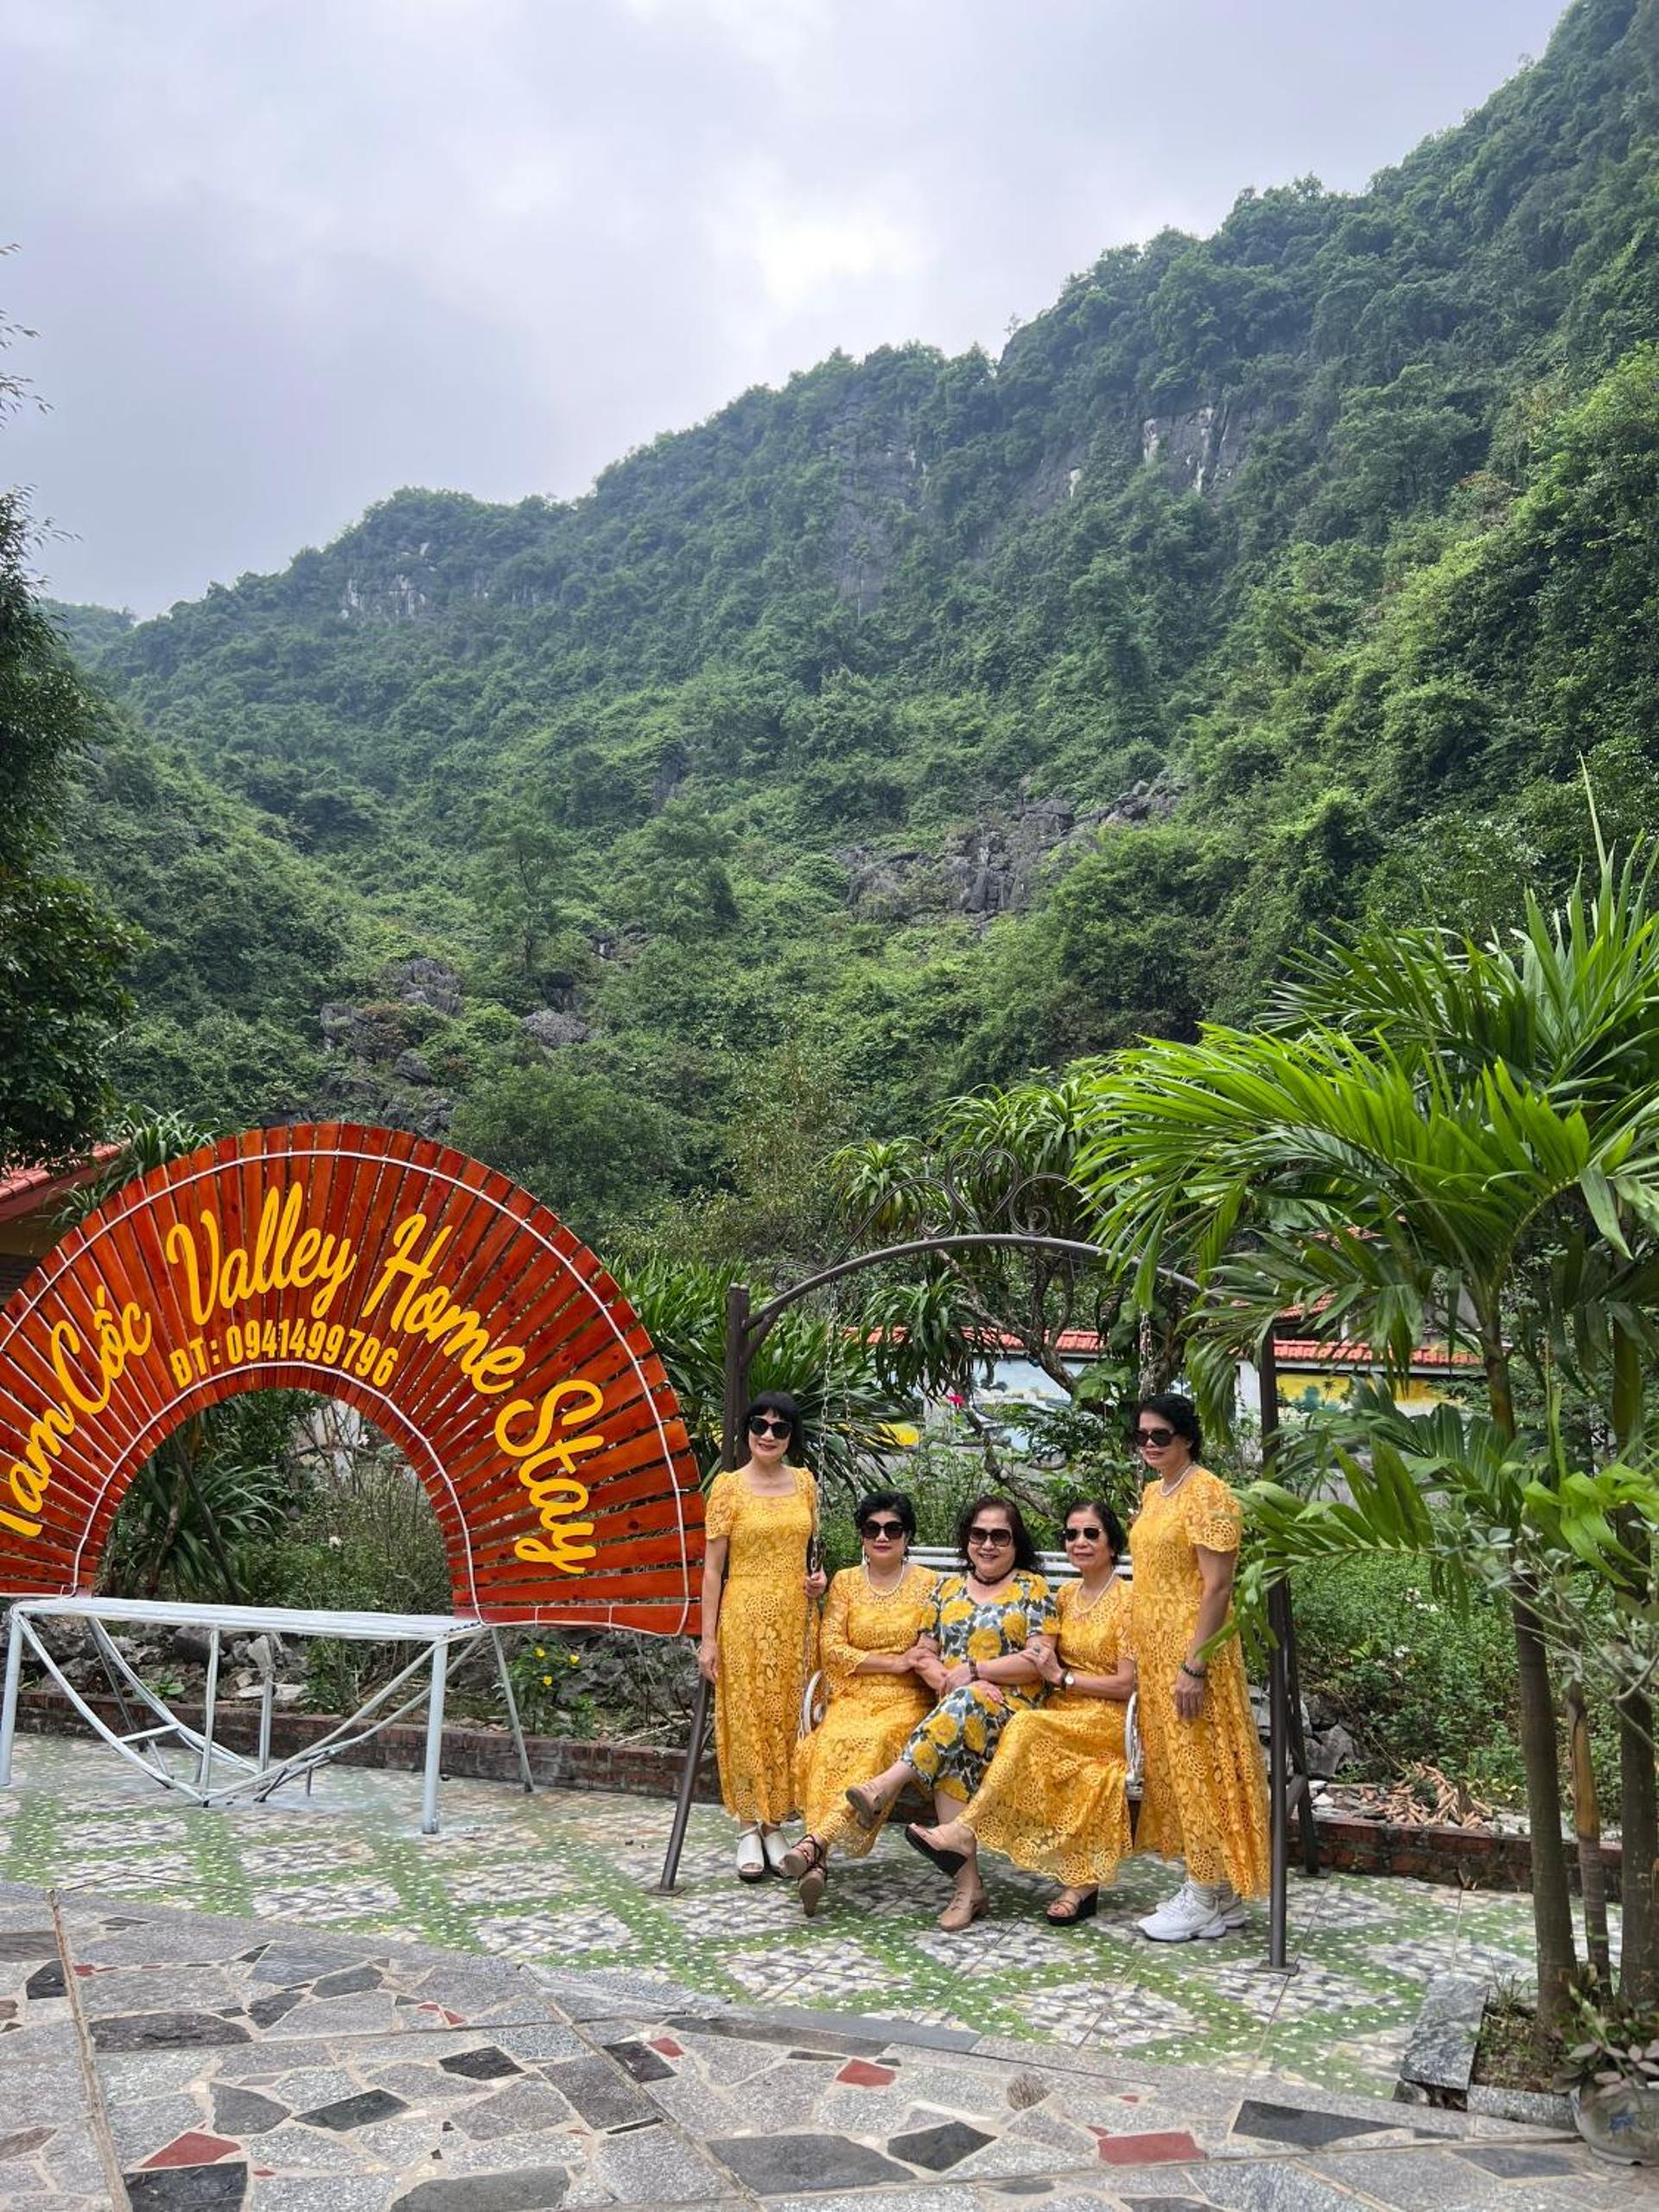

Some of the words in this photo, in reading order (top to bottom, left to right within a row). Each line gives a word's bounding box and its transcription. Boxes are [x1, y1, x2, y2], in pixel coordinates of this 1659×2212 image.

[51, 1285, 152, 1414] Cốc
[166, 1182, 356, 1326] Valley
[361, 1212, 525, 1395] Home
[494, 1380, 604, 1575] Stay
[226, 1318, 399, 1388] 0941499796
